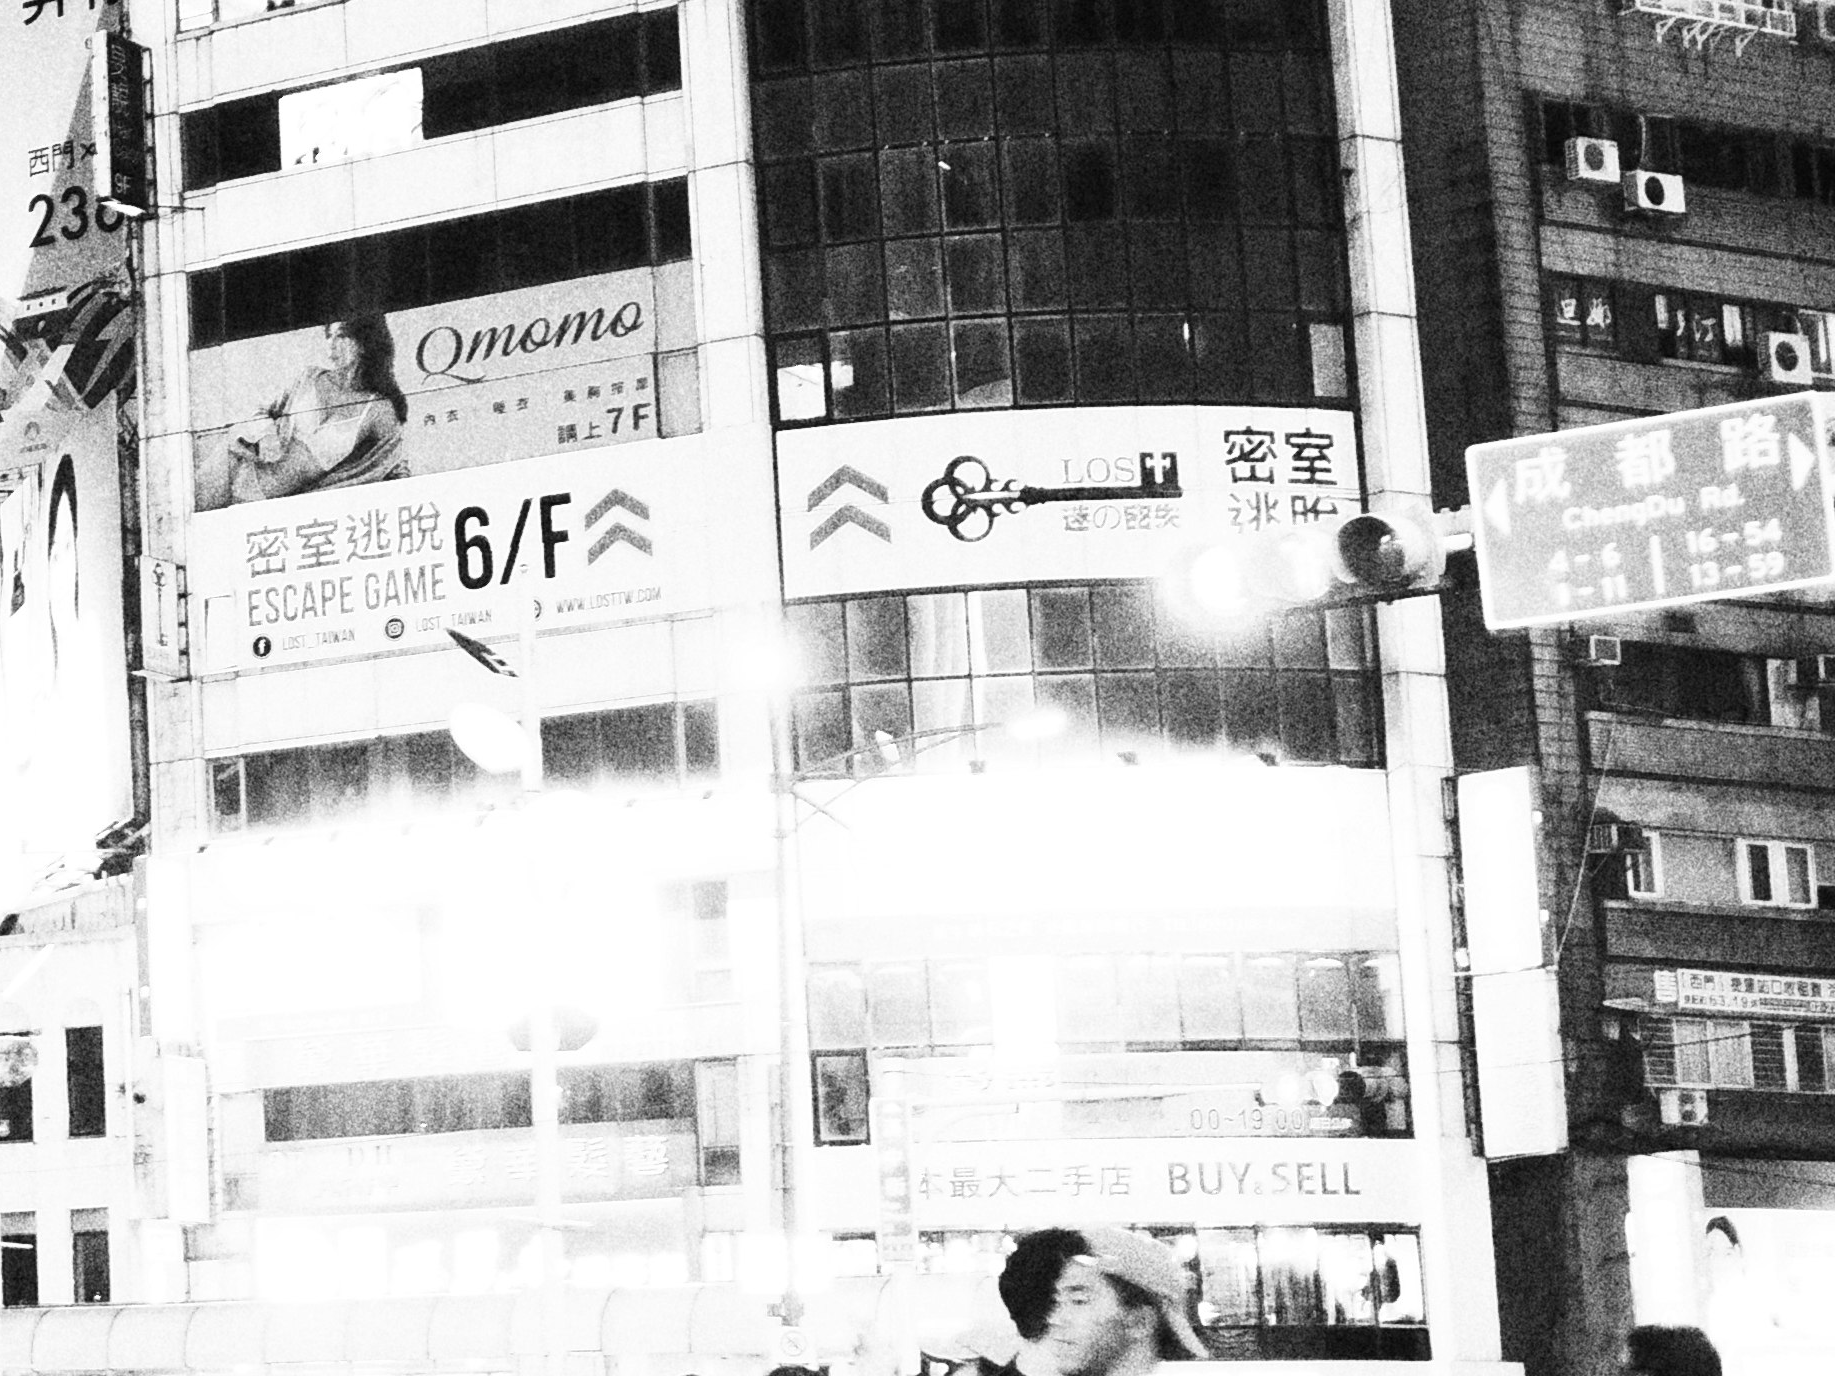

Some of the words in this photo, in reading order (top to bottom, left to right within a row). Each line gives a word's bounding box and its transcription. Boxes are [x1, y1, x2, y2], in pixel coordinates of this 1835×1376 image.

[414, 298, 646, 385] Qmomo
[1221, 423, 1340, 488] 密室
[1515, 412, 1781, 505] 成都路
[244, 500, 445, 580] 密室逃脫
[451, 489, 574, 592] 6/F
[1561, 494, 1686, 531] ChengDu
[1698, 483, 1746, 511] Rd.
[246, 574, 355, 629] ESCAPE
[363, 562, 448, 609] GAME
[1269, 1160, 1365, 1197] SELL
